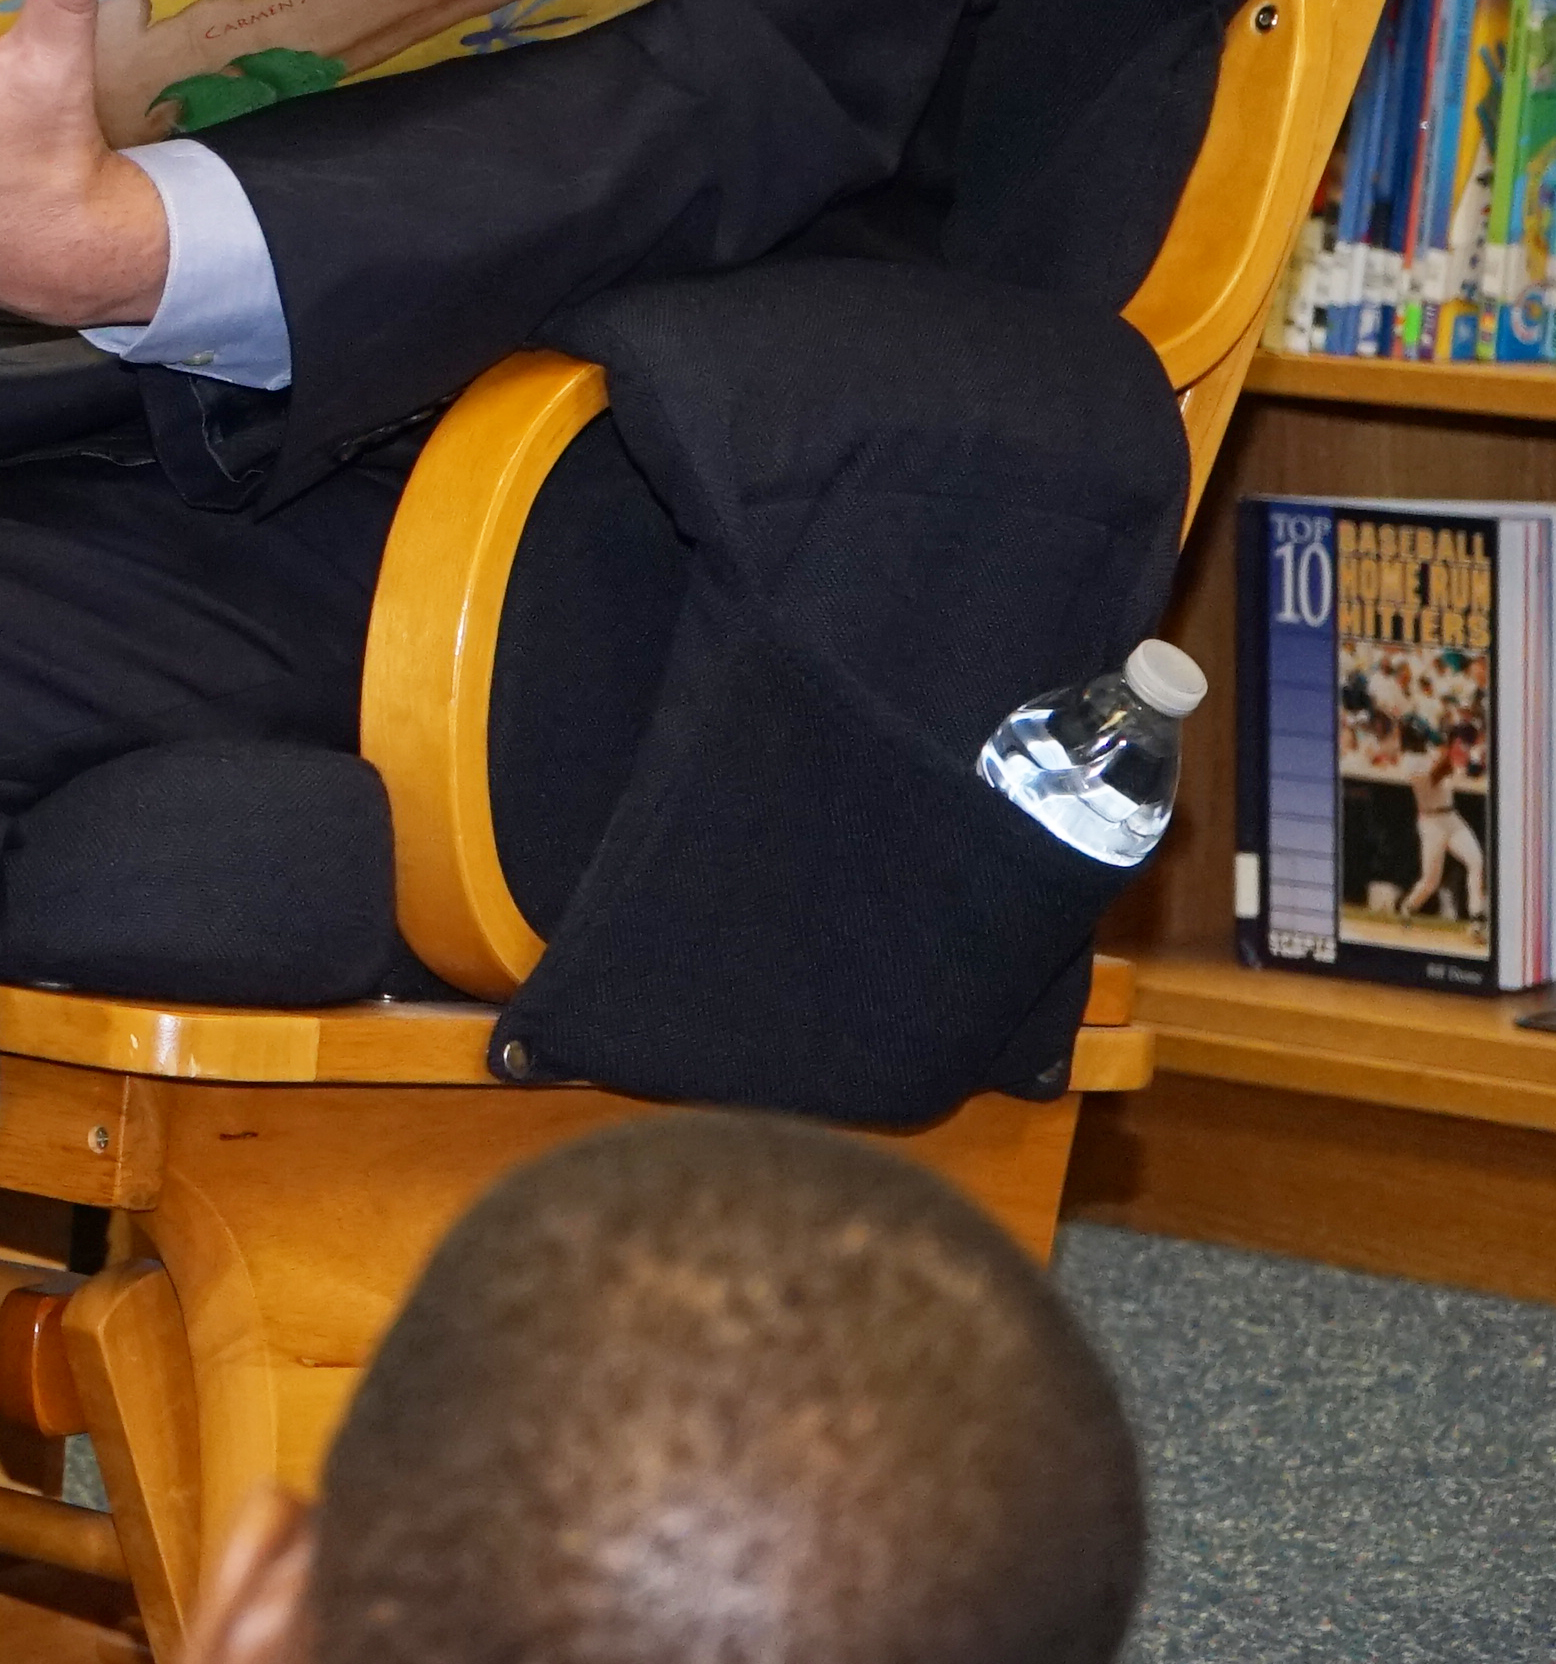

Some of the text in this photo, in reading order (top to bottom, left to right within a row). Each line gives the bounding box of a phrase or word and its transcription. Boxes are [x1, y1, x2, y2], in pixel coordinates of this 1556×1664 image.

[204, 0, 293, 39] CARMEN
[1338, 518, 1490, 565] BASEBALL
[1270, 513, 1332, 628] TOP 10
[1338, 555, 1491, 612] HOME RUN
[1338, 601, 1490, 649] HITTERS
